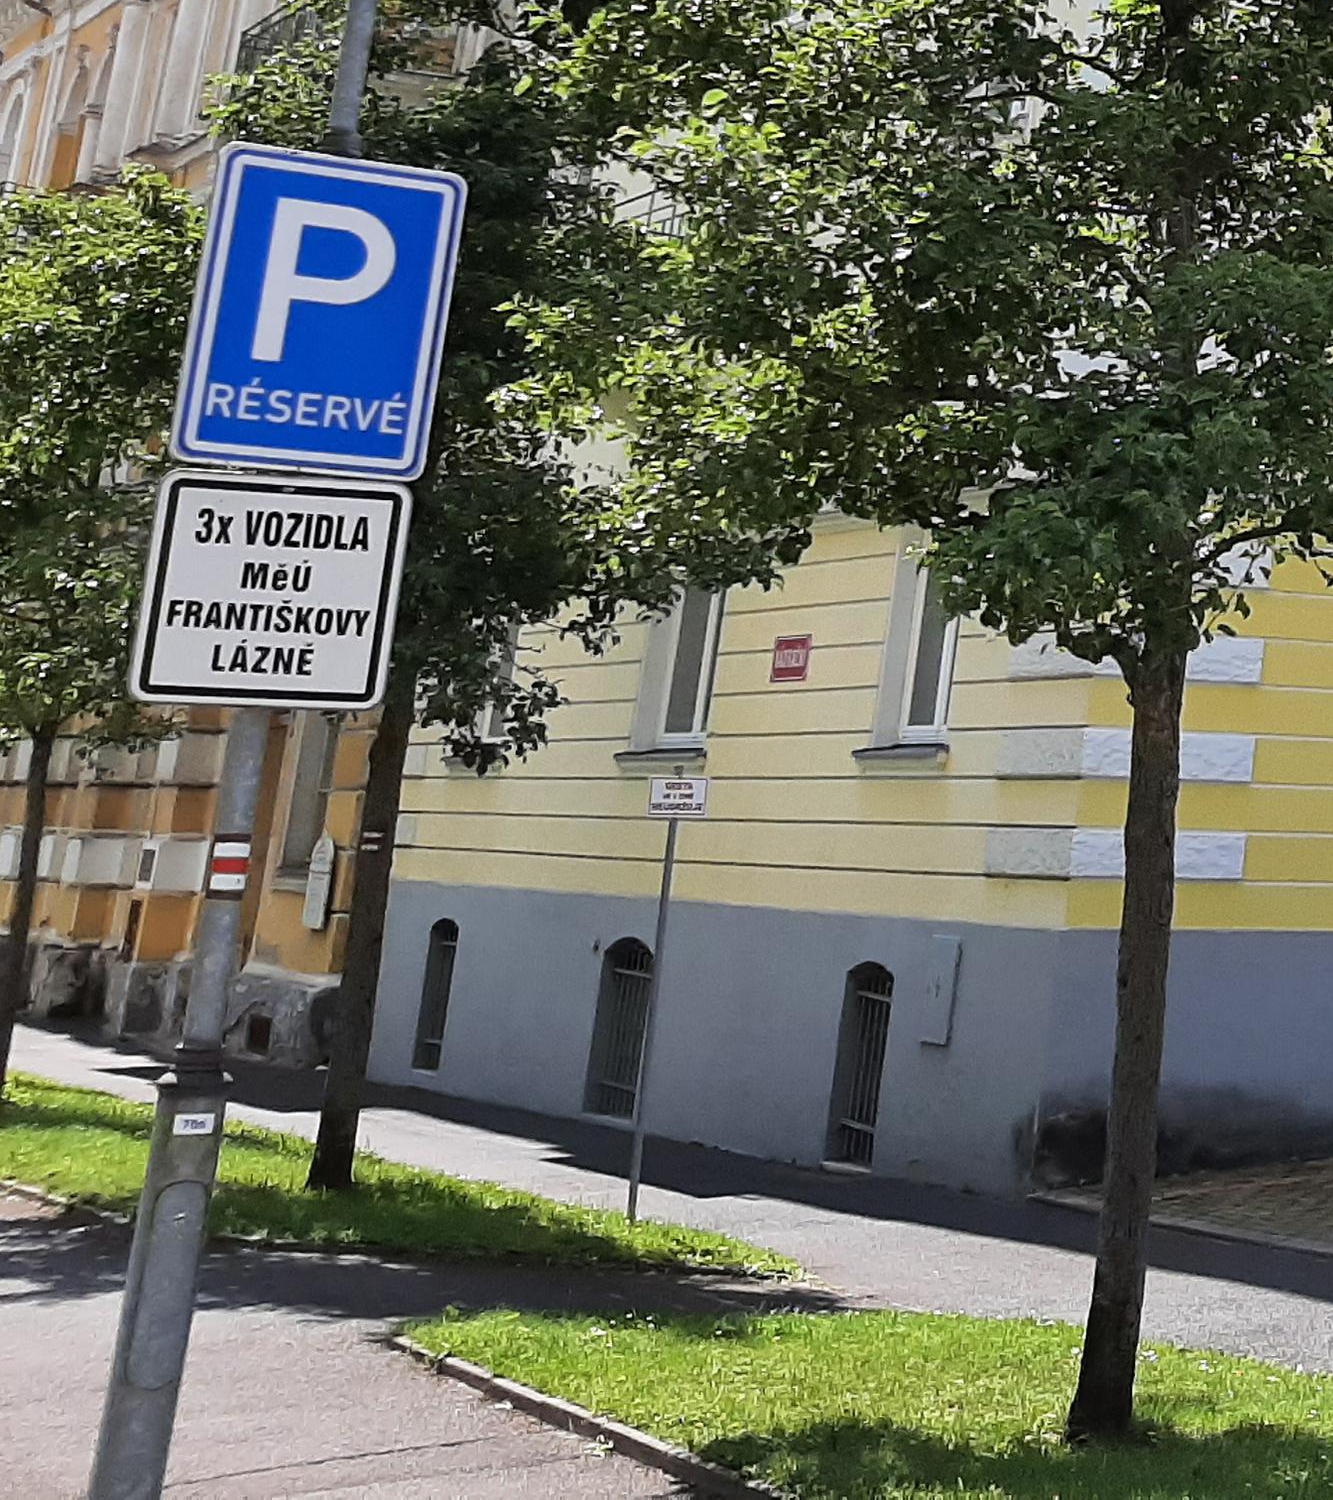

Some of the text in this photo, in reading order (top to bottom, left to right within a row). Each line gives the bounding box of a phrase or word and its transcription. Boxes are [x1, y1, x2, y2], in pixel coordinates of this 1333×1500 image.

[251, 197, 397, 362] P
[204, 378, 407, 435] RÉSERVÉ
[195, 508, 369, 551] 3x VOZIDLA
[240, 559, 312, 592] MěÚ
[166, 599, 371, 637] FRANTIŠKOVY
[211, 638, 314, 676] LÁZNĚ
